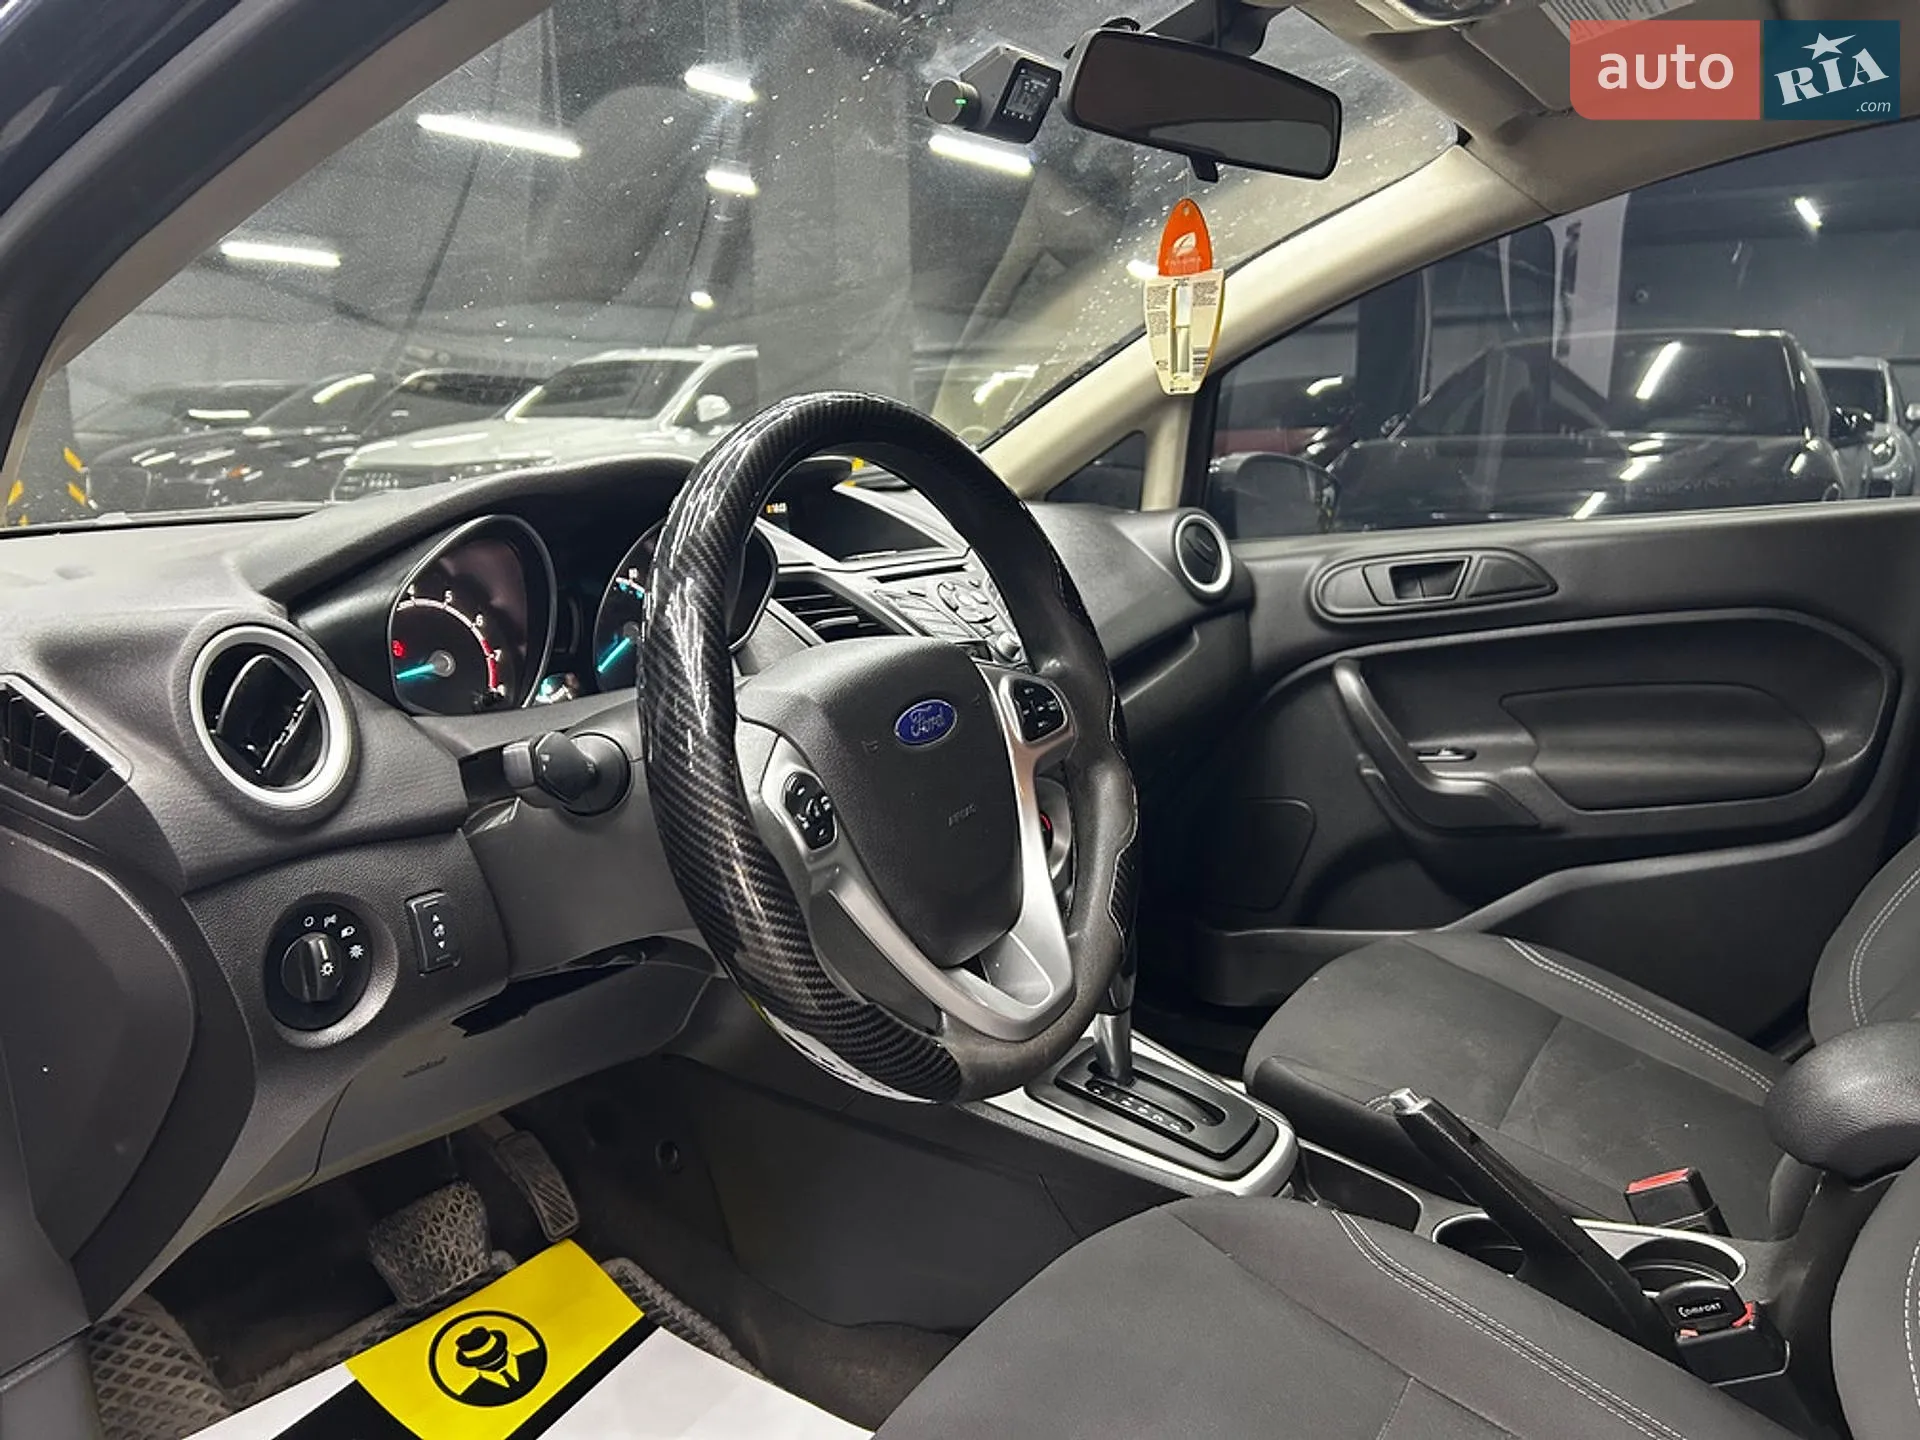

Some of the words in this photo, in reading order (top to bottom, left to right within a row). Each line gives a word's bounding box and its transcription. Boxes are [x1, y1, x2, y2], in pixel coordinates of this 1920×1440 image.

[444, 590, 453, 602] 5
[475, 613, 484, 627] 6
[493, 649, 503, 662] 7
[909, 705, 946, 737] Ford
